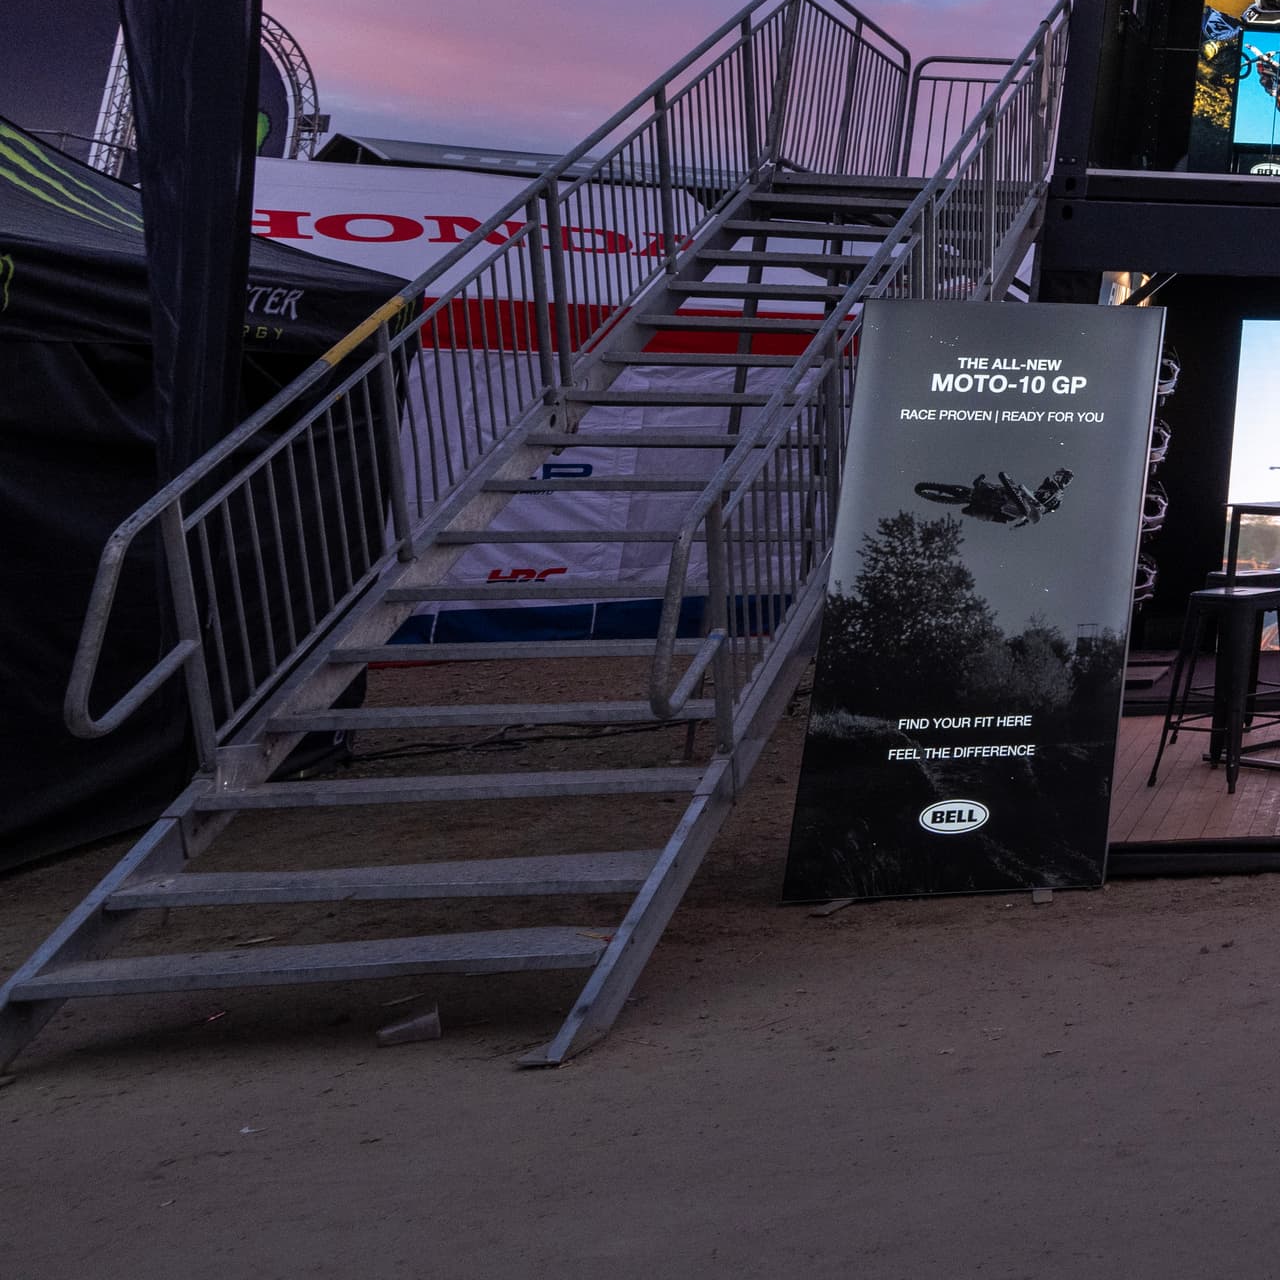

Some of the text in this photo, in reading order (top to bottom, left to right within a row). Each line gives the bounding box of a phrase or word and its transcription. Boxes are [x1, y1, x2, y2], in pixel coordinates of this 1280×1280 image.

[957, 357, 1062, 372] THE ALL-NEW
[931, 374, 1088, 395] MOTO-10 GP
[900, 409, 937, 421] RACE
[938, 409, 992, 422] PROVEN
[1001, 410, 1045, 423] READY
[1046, 410, 1074, 423] FOR
[1075, 411, 1104, 423] YOU
[898, 715, 1032, 730] FIND YOUR FIT HERE
[888, 744, 1036, 761] FEEL THE DIFFERENCE
[930, 809, 978, 824] BELL
